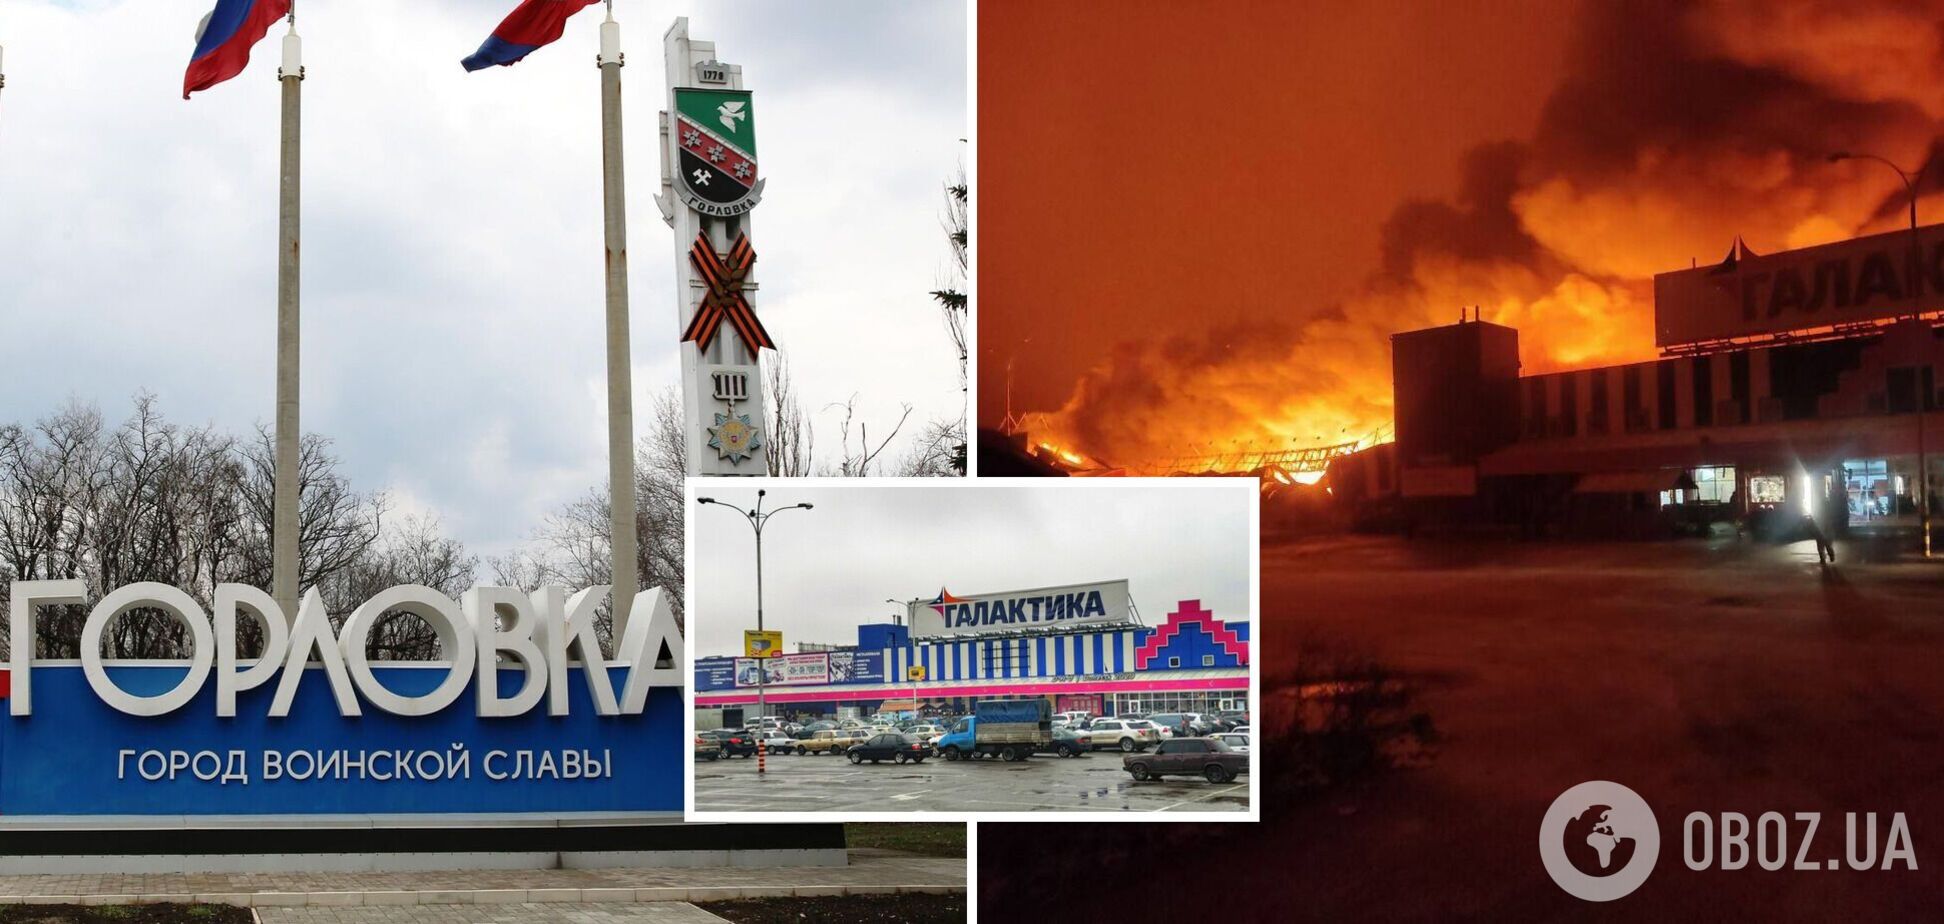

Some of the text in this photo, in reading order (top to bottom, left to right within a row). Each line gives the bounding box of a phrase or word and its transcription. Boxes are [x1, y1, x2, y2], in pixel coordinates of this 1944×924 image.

[688, 198, 756, 216] ГОРЛОВКА
[944, 591, 1105, 628] ГАЛАКТИКА
[10, 581, 685, 718] ГОРЛОВКА
[118, 743, 612, 785] ГОРОД ВОИНСКОЙ СЛАВЫ
